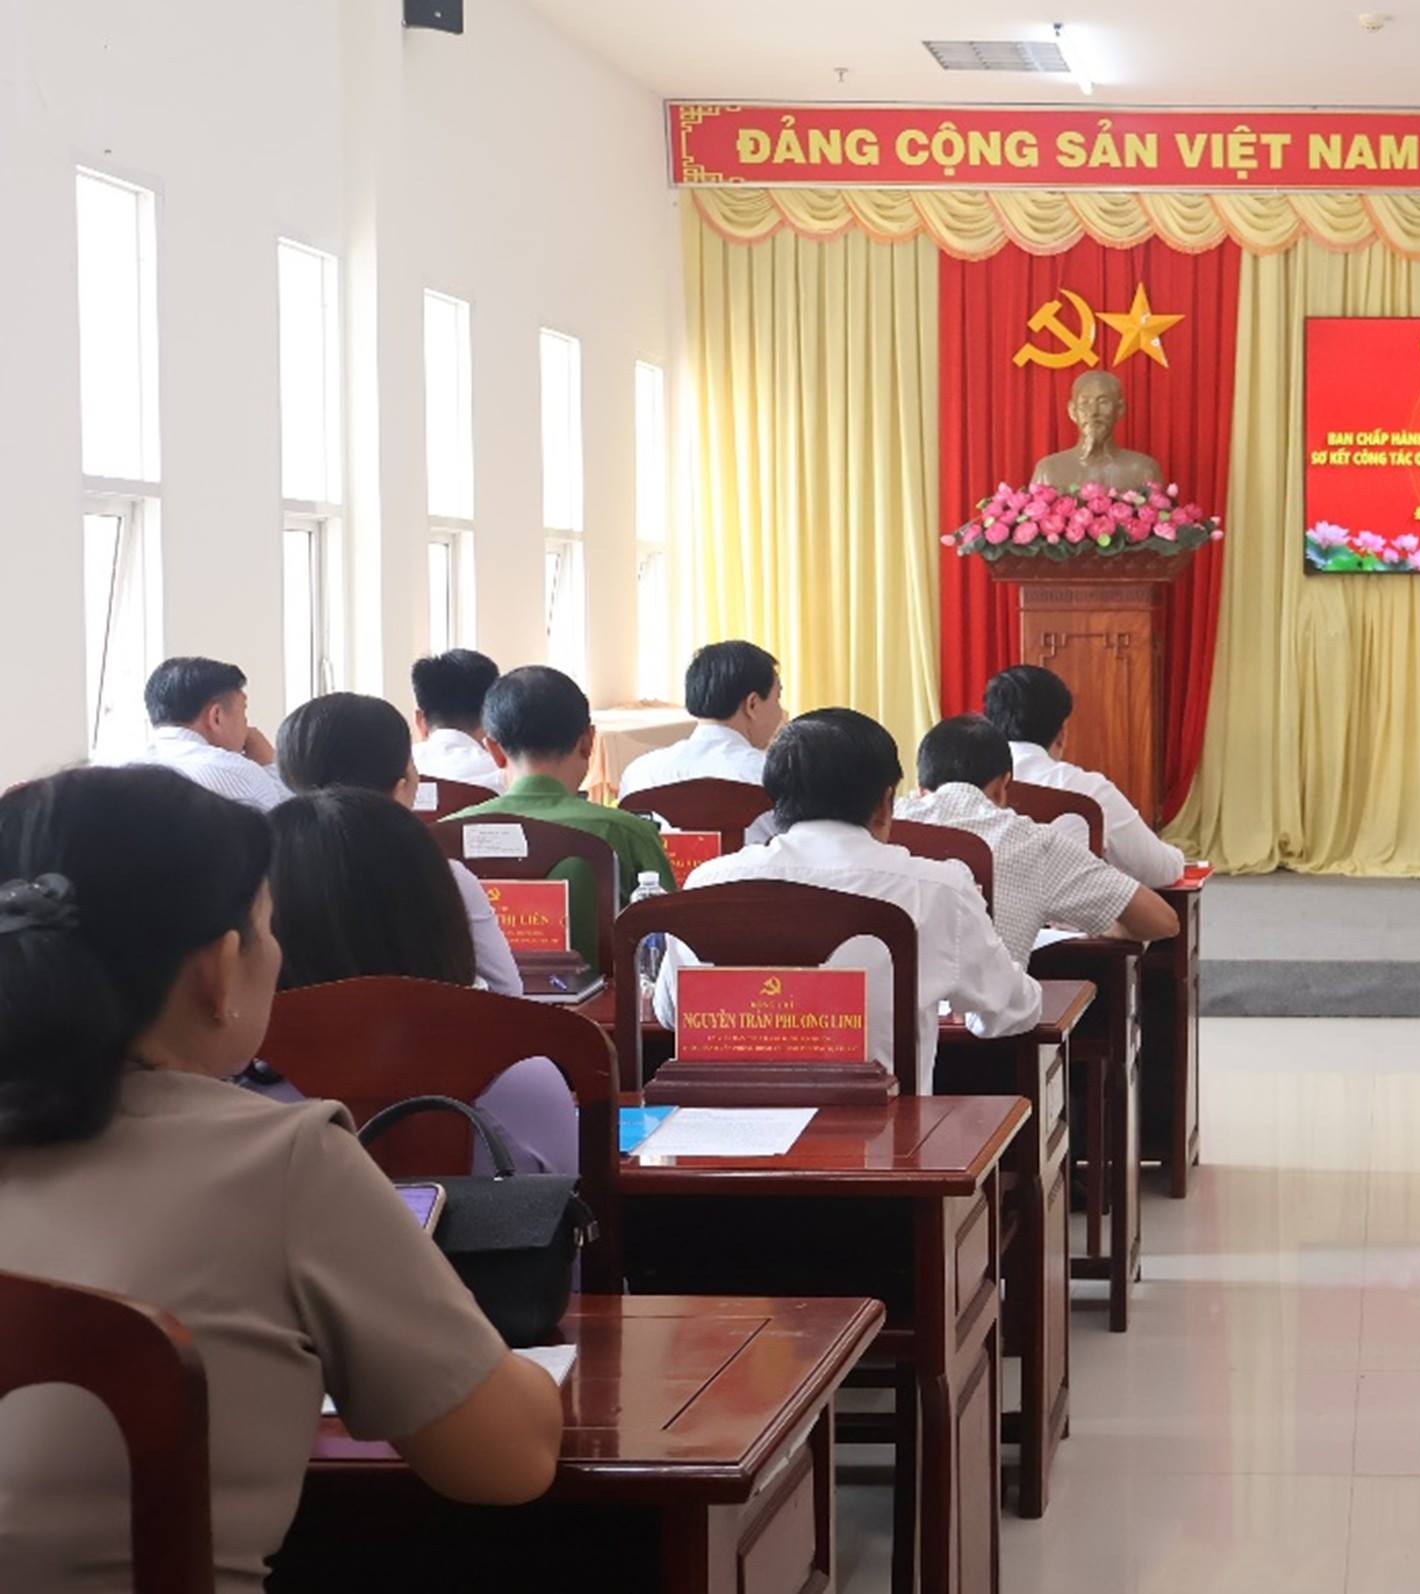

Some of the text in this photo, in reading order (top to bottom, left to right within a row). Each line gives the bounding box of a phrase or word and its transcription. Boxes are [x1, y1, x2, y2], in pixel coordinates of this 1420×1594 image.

[736, 116, 879, 165] ĐẢNG
[895, 123, 1038, 176] CỘNG
[1056, 119, 1159, 168] SẢN
[1175, 125, 1291, 179] VIỆT
[1309, 134, 1419, 169] NAM
[1328, 432, 1353, 446] BAN
[1356, 428, 1389, 446] CHẤP
[1311, 451, 1327, 466] SƠ
[1330, 447, 1351, 466] KẾT
[1353, 449, 1387, 466] CÔNG
[1389, 449, 1412, 466] TÁC
[830, 1013, 862, 1029] LINH
